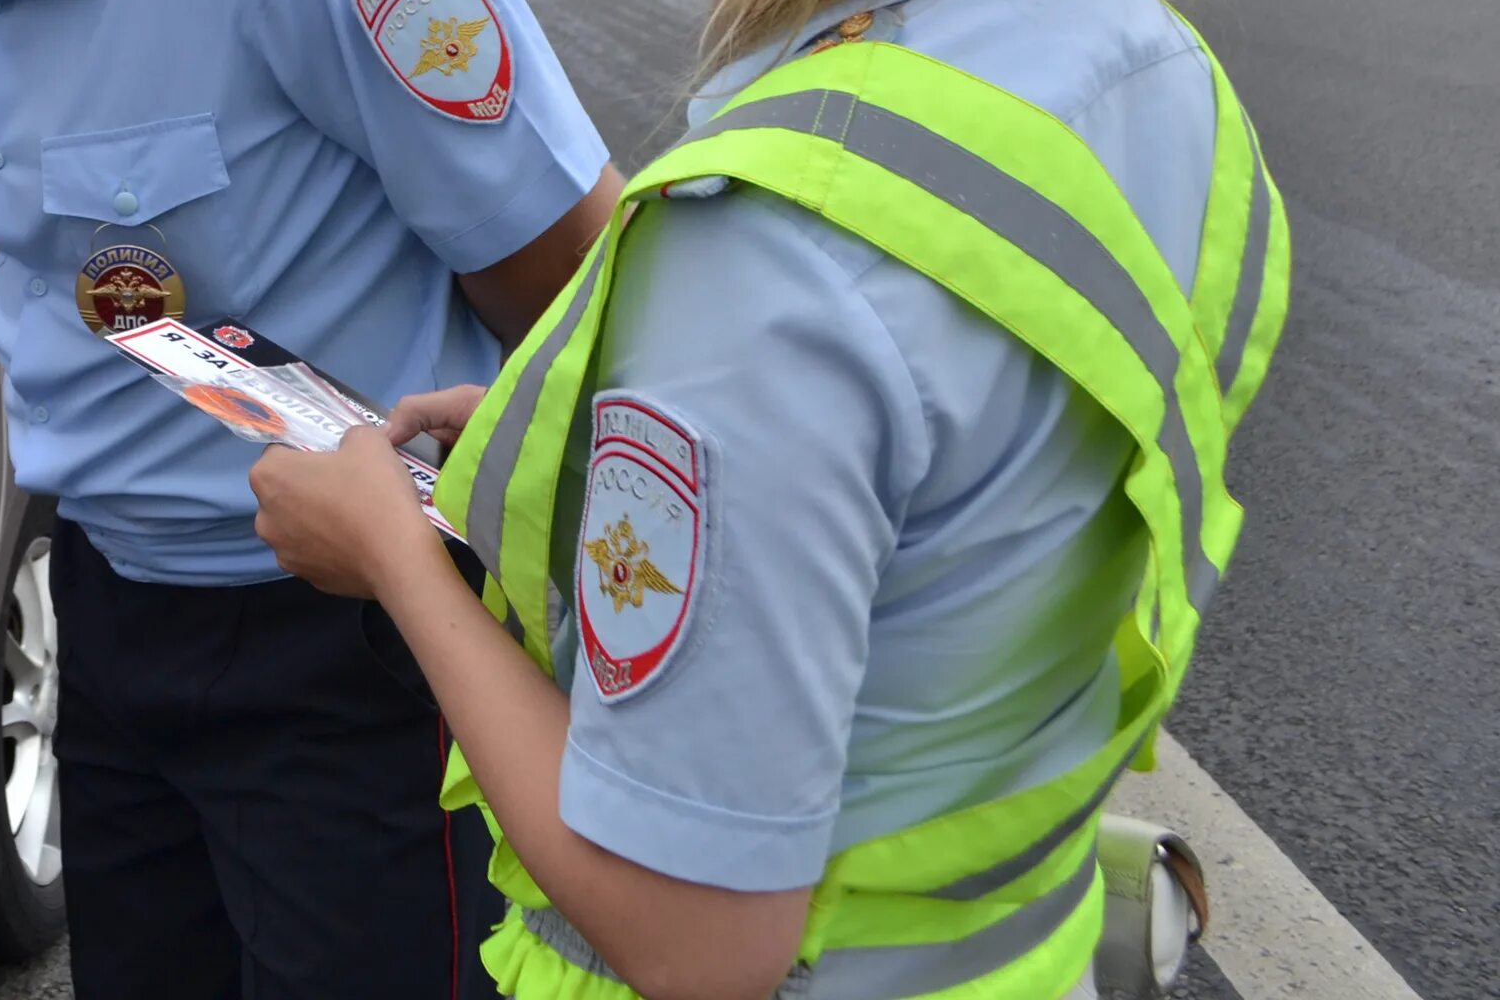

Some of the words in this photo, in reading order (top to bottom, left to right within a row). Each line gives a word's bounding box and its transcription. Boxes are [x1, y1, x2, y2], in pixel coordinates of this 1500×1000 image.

[467, 83, 507, 117] МВД
[86, 249, 170, 278] ПОЛИЦИЯ
[113, 315, 148, 329] ДПС
[160, 332, 186, 342] Я
[192, 350, 229, 369] ЗА
